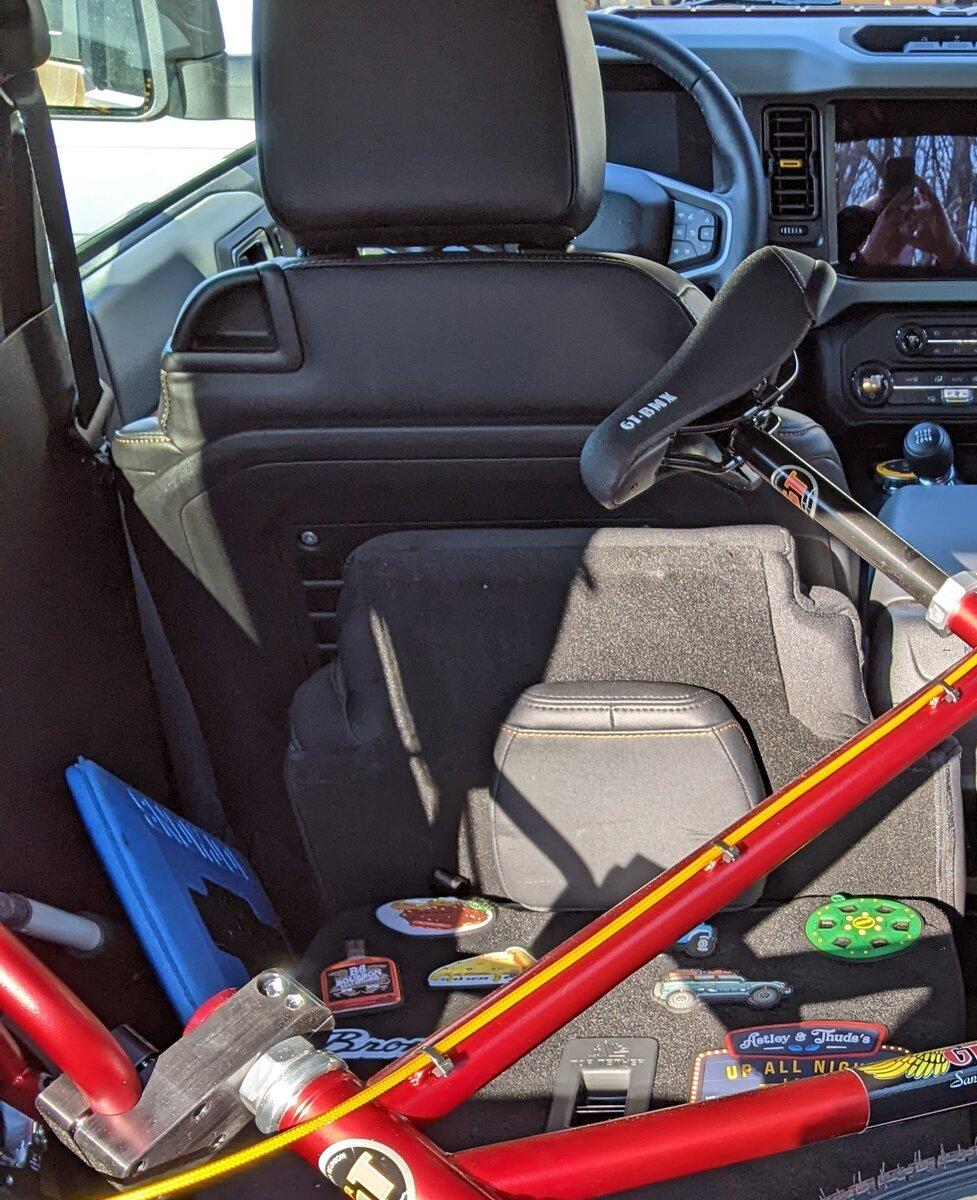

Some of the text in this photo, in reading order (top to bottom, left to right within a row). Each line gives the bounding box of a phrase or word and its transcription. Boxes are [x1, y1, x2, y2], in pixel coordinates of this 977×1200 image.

[323, 1031, 420, 1053] Bro
[739, 1032, 791, 1049] Astley
[795, 1031, 807, 1042] &
[726, 1063, 752, 1080] UP
[764, 1060, 802, 1075] ALL
